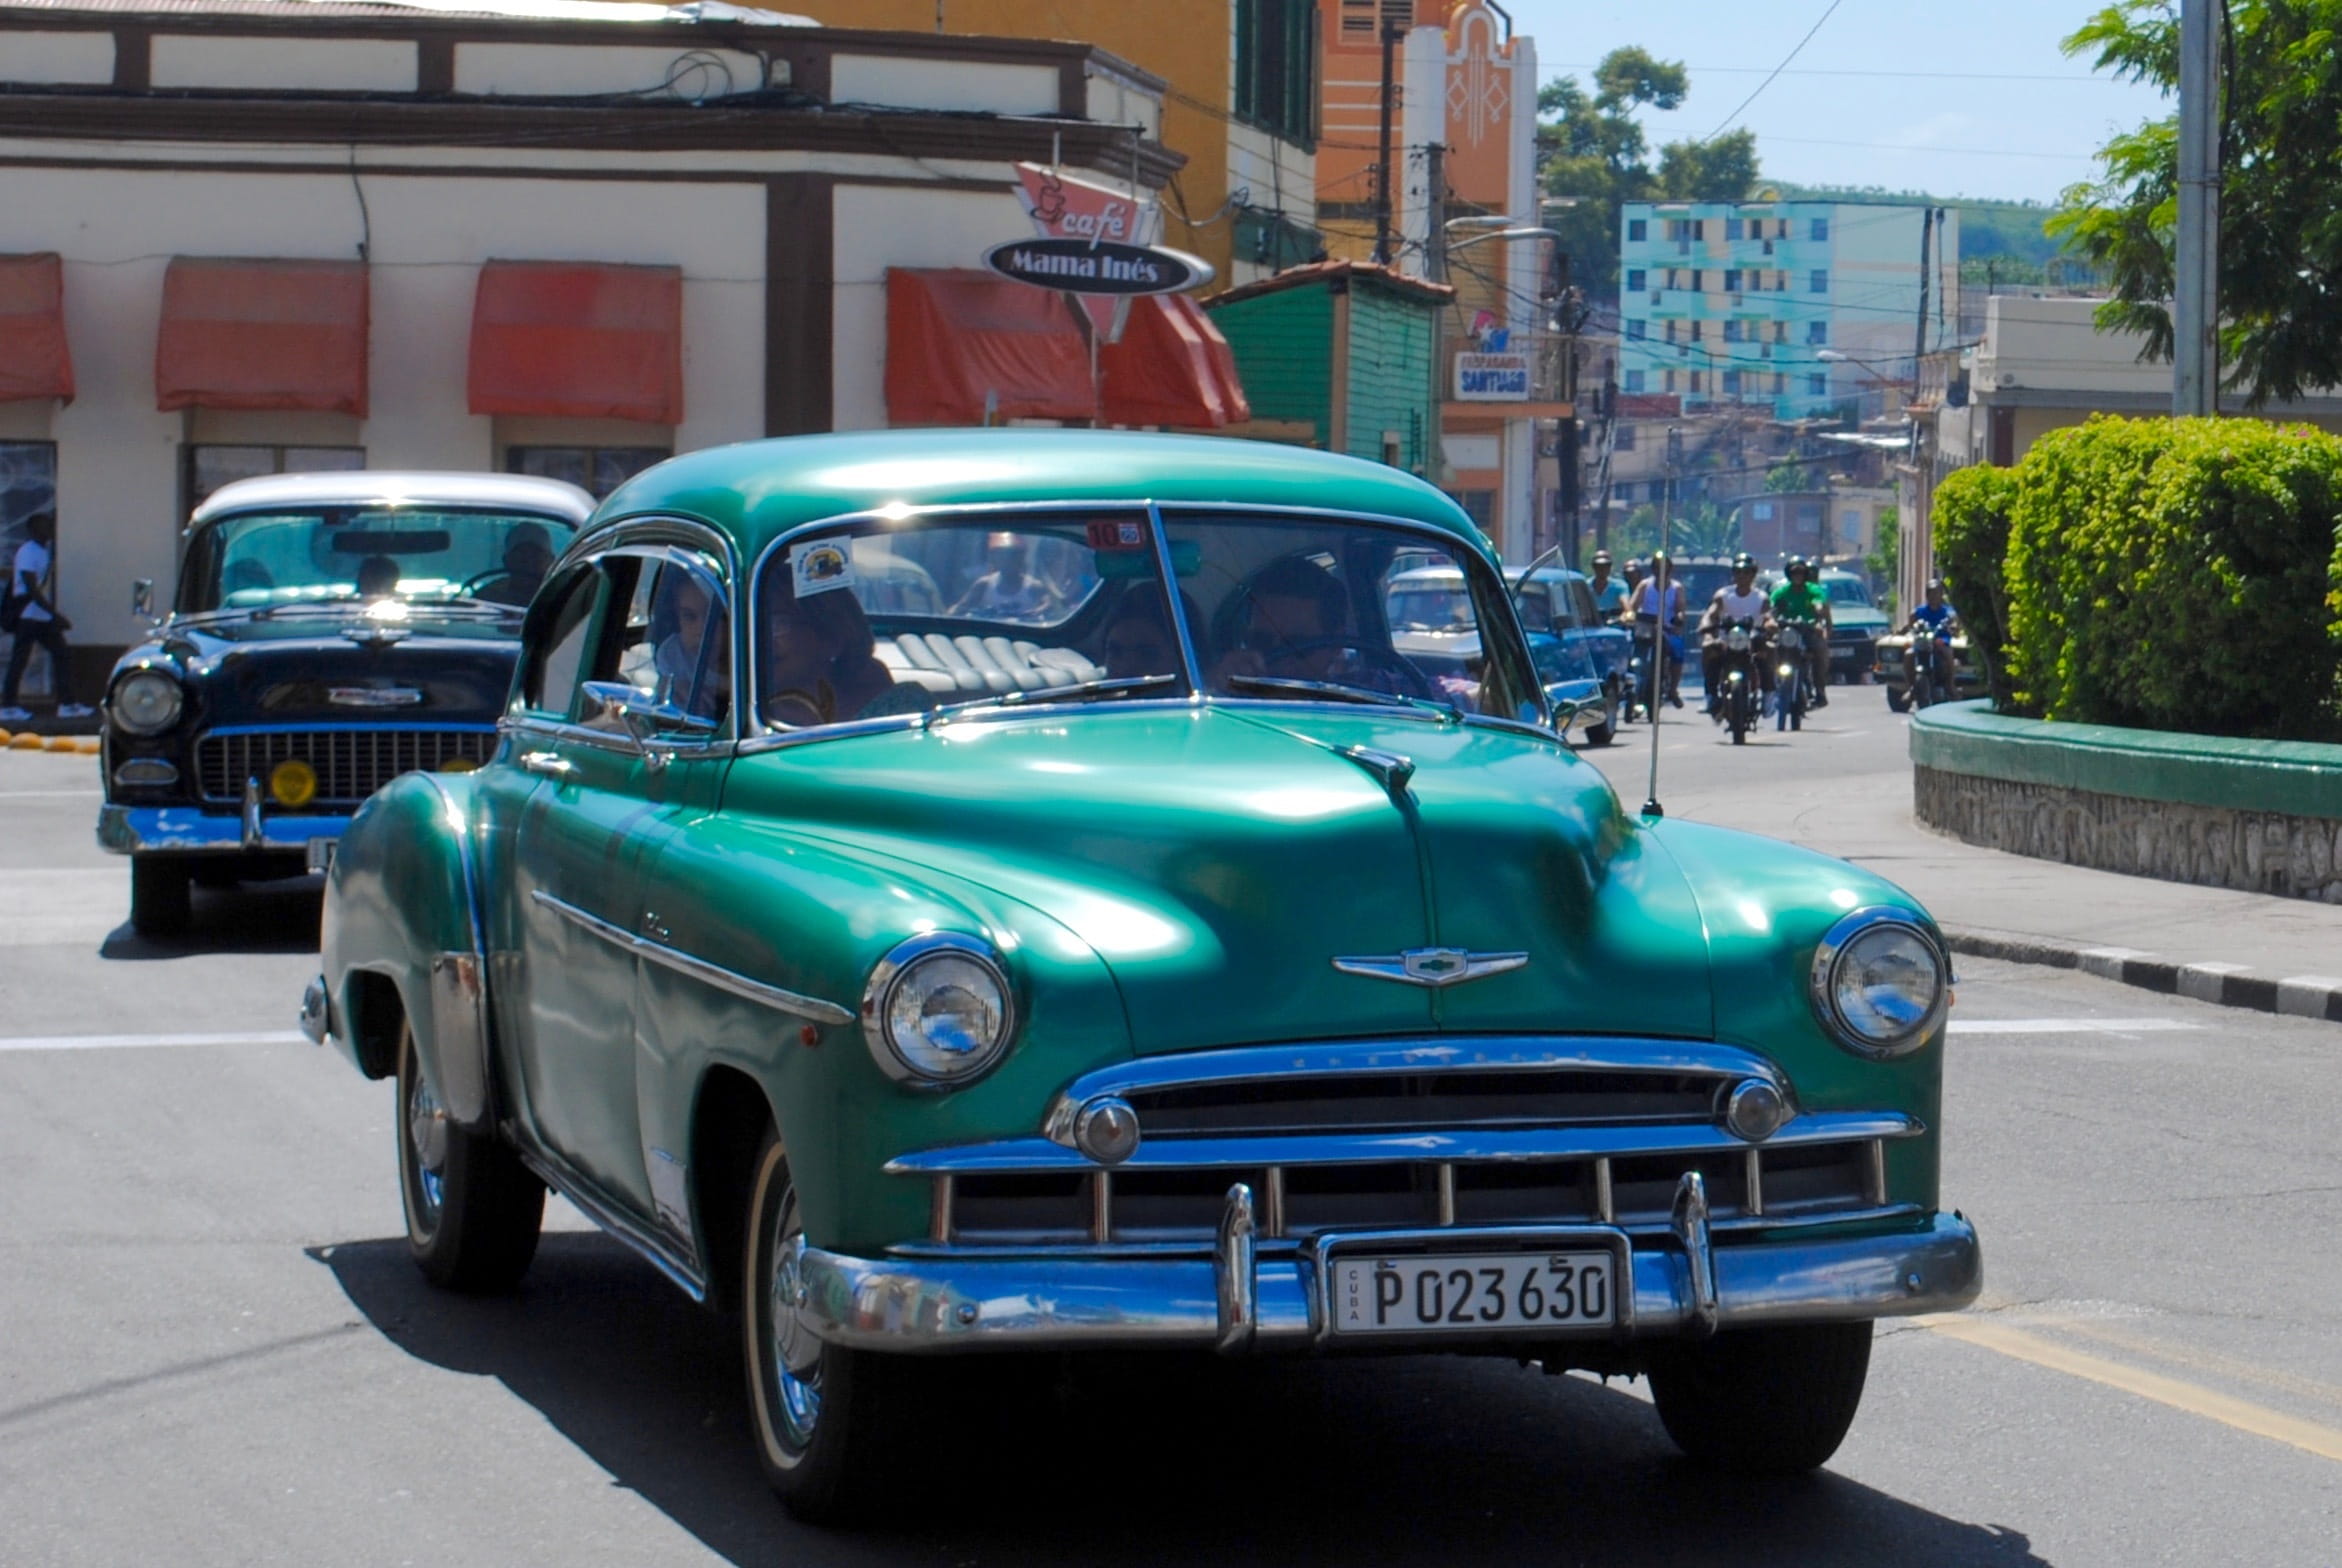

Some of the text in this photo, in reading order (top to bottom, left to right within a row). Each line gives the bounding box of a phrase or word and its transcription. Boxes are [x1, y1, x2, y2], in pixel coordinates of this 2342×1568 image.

[1061, 203, 1125, 250] café
[1011, 250, 1159, 283] Mama Inés
[1461, 370, 1526, 393] SANTIAGO
[1349, 1270, 1359, 1321] CUBA
